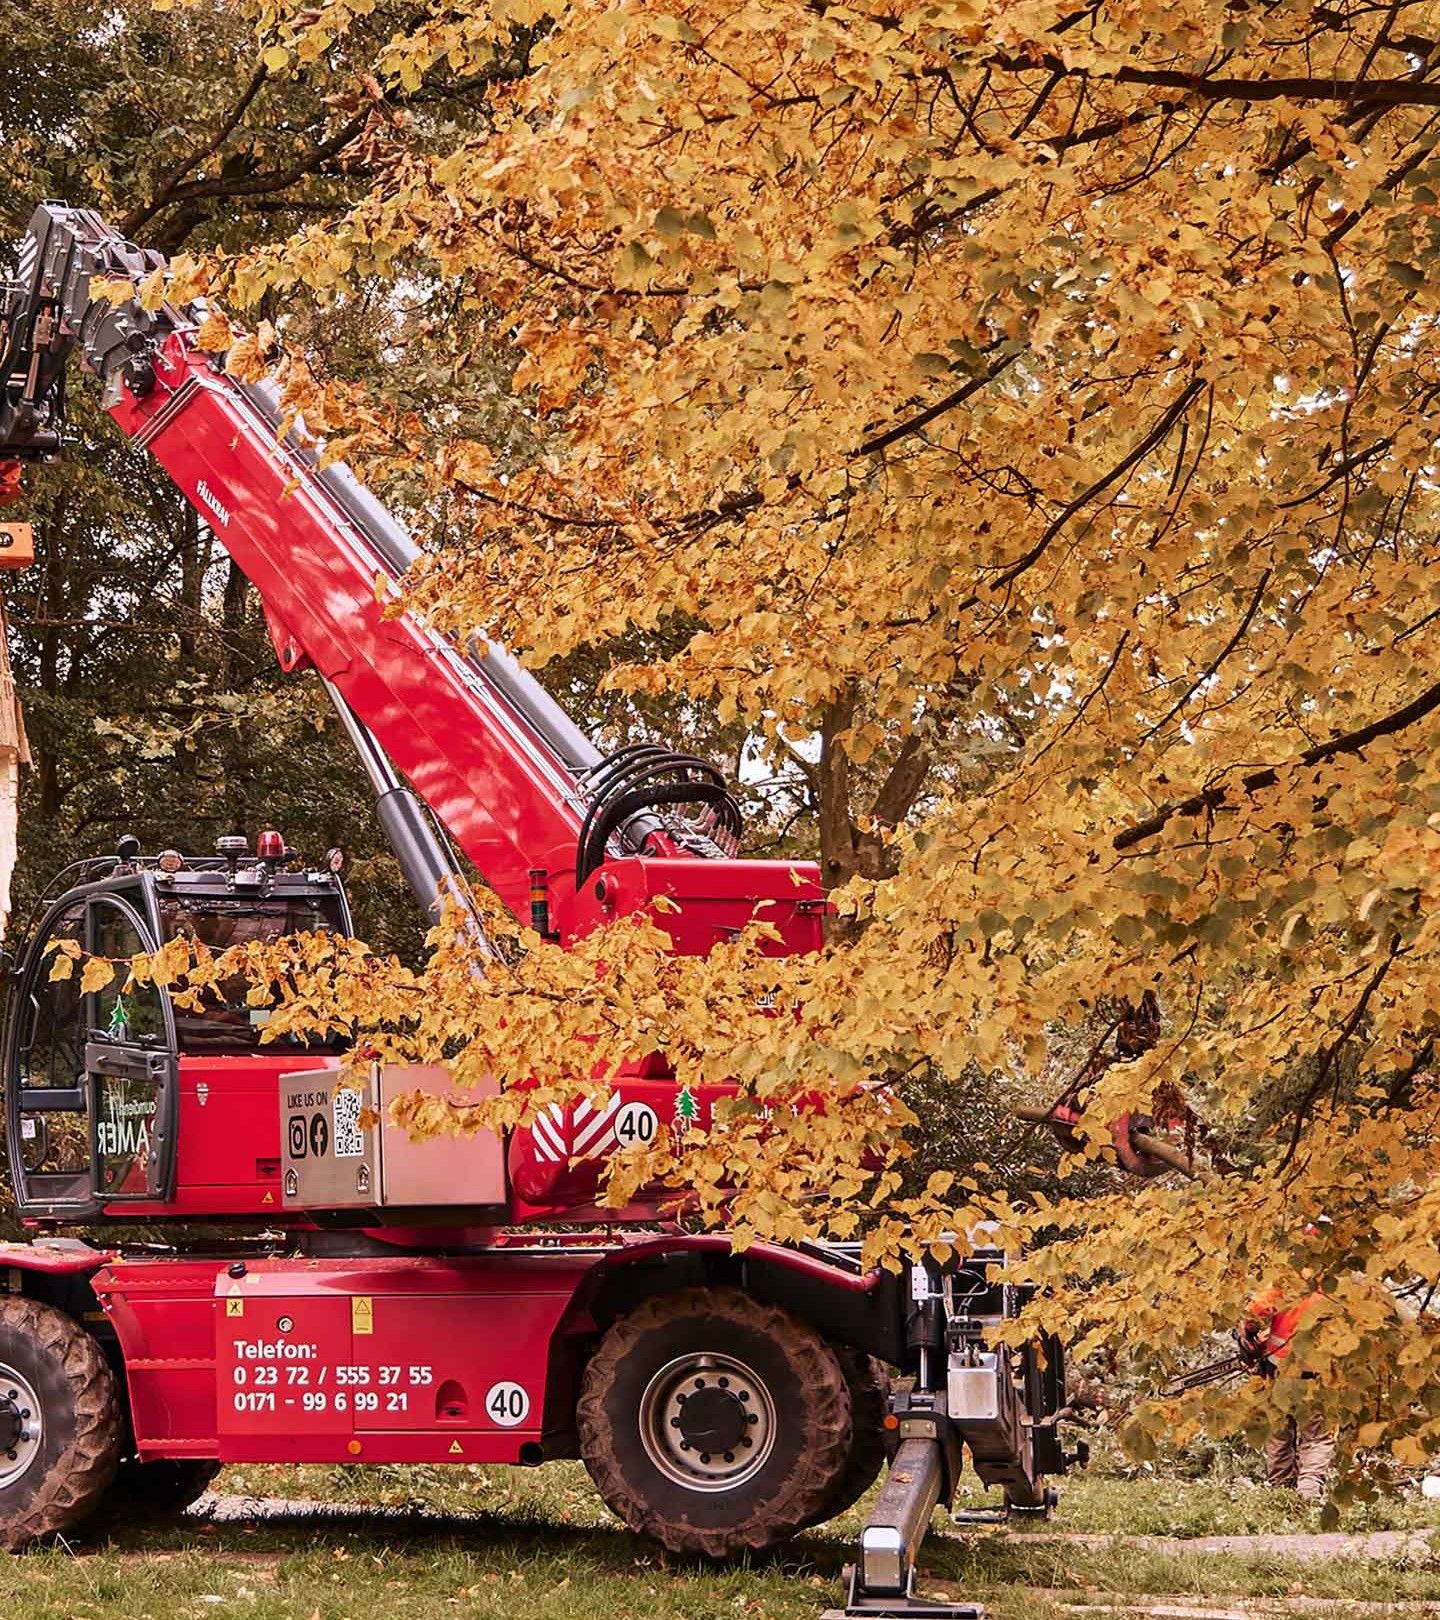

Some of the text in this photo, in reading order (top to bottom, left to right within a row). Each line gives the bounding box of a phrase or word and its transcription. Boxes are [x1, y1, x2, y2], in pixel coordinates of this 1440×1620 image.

[287, 1091, 328, 1109] LIKE US ON
[620, 1110, 653, 1142] 40
[233, 1339, 317, 1359] Telefon:
[233, 1366, 433, 1385] 0 23 72 / 555 37 55
[233, 1392, 276, 1411] 0171
[302, 1392, 326, 1411] 99
[334, 1392, 347, 1411] 6
[354, 1392, 379, 1411] 99
[386, 1392, 408, 1411] 21
[490, 1389, 524, 1418] 40
